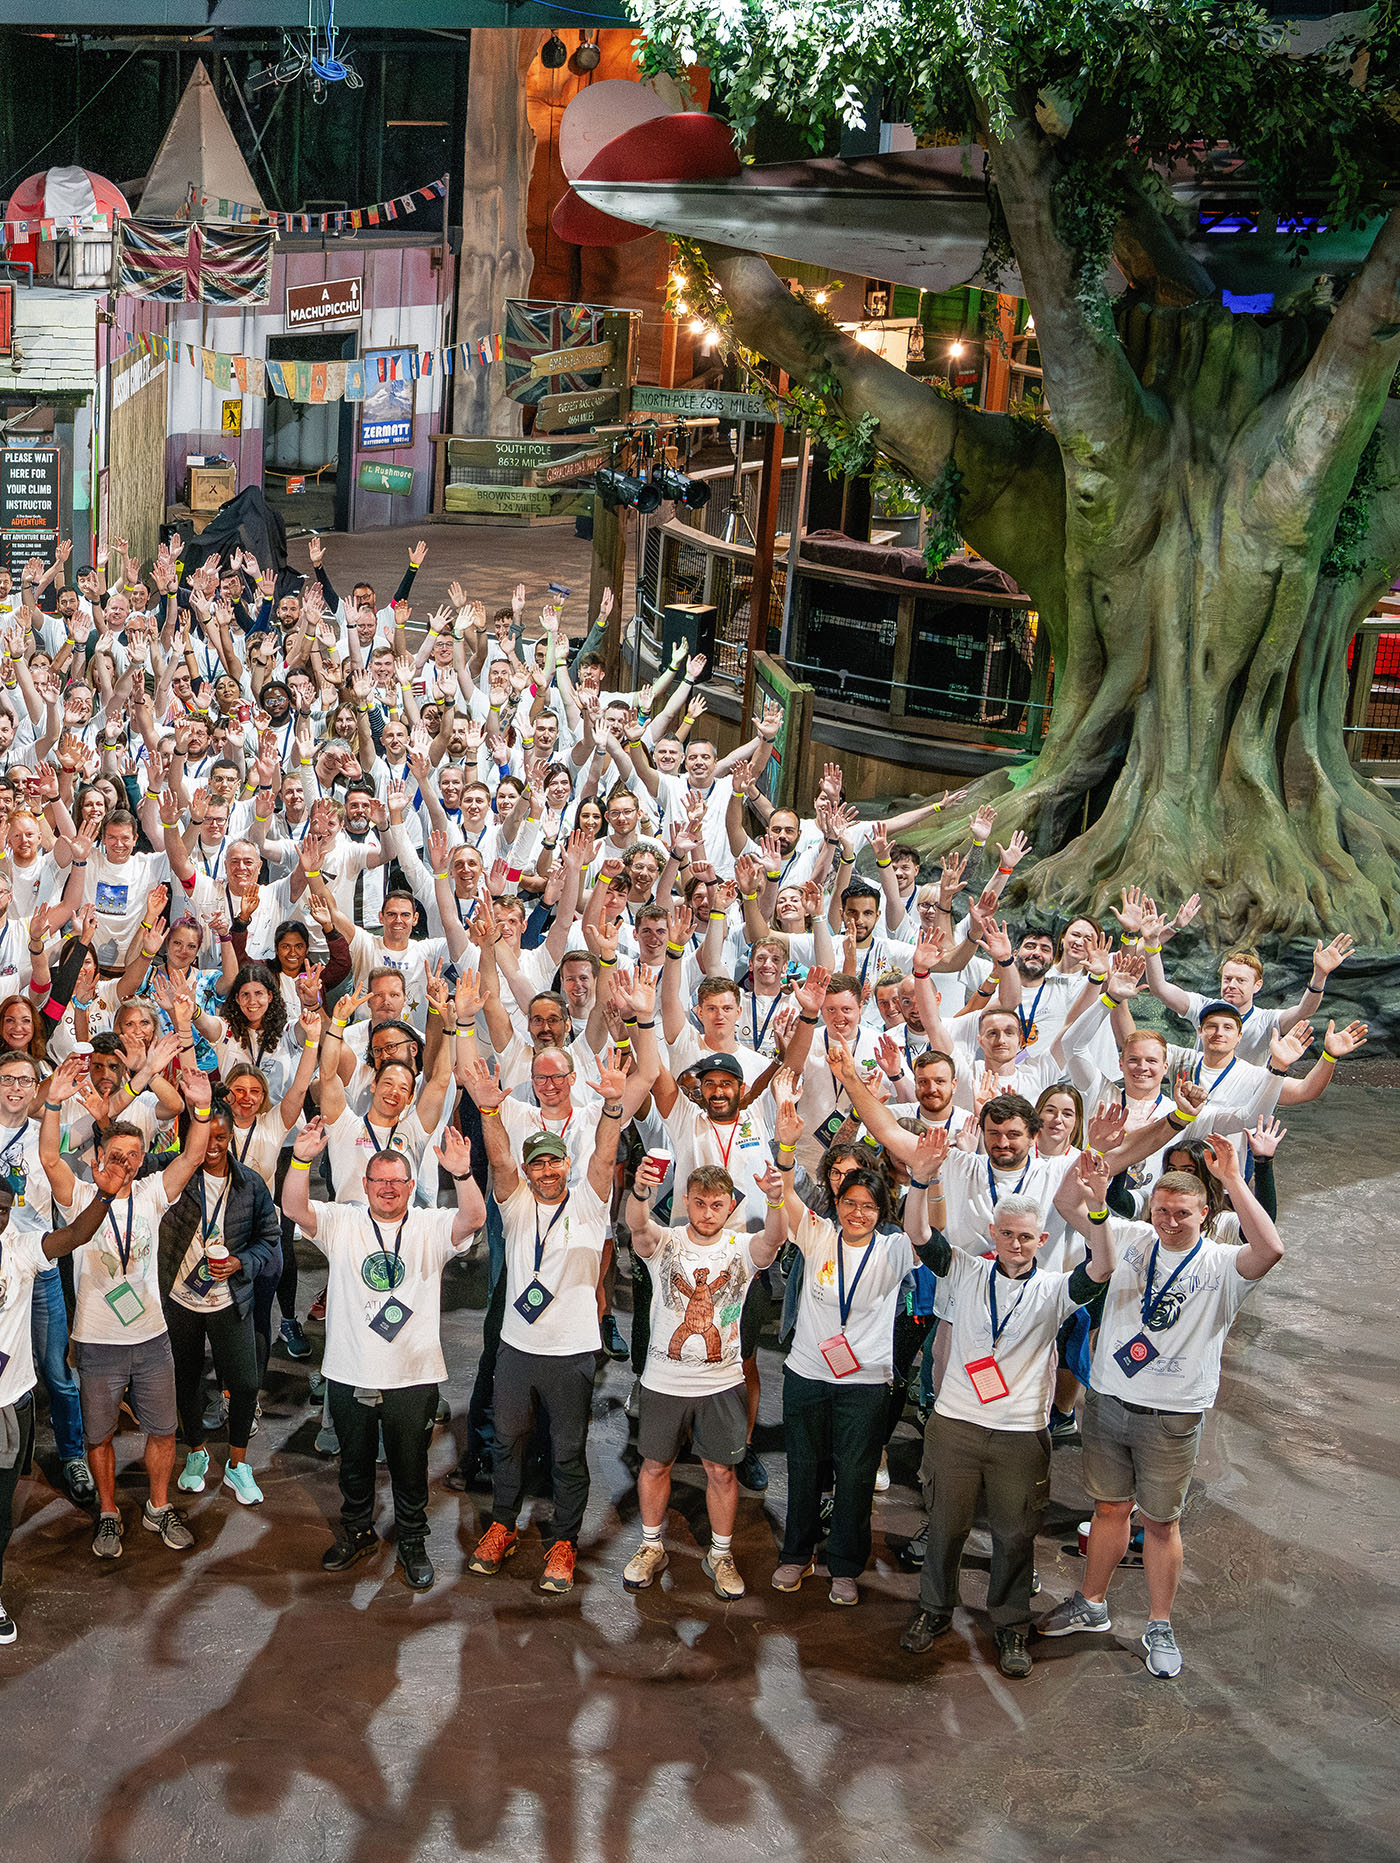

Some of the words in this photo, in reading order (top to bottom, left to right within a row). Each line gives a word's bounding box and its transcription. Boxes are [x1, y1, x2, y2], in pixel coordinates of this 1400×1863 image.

[321, 288, 330, 301] A
[290, 299, 360, 321] MACHUPICCHU
[640, 392, 671, 408] NORTH
[673, 395, 697, 410] POLE
[701, 397, 724, 411] 2593
[730, 399, 761, 414] MILES
[363, 423, 410, 440] ZERMATT
[495, 444, 527, 454] SOUTH
[528, 445, 551, 455] POLE
[5, 453, 33, 463] PLEASE
[34, 453, 54, 463] WAIT
[498, 457, 520, 467] 8632
[10, 469, 30, 478] HERE
[31, 469, 46, 478] FOR
[374, 465, 412, 479] Rushmore
[6, 485, 27, 494] YOUR
[28, 485, 52, 494] CLIMB
[477, 491, 527, 501] BROWNSEA
[528, 492, 562, 504] ISLAND
[6, 500, 52, 510] INSTRUCTOR
[497, 503, 514, 512] 124
[514, 504, 542, 512] MILES
[11, 518, 47, 526] ADVENTURE
